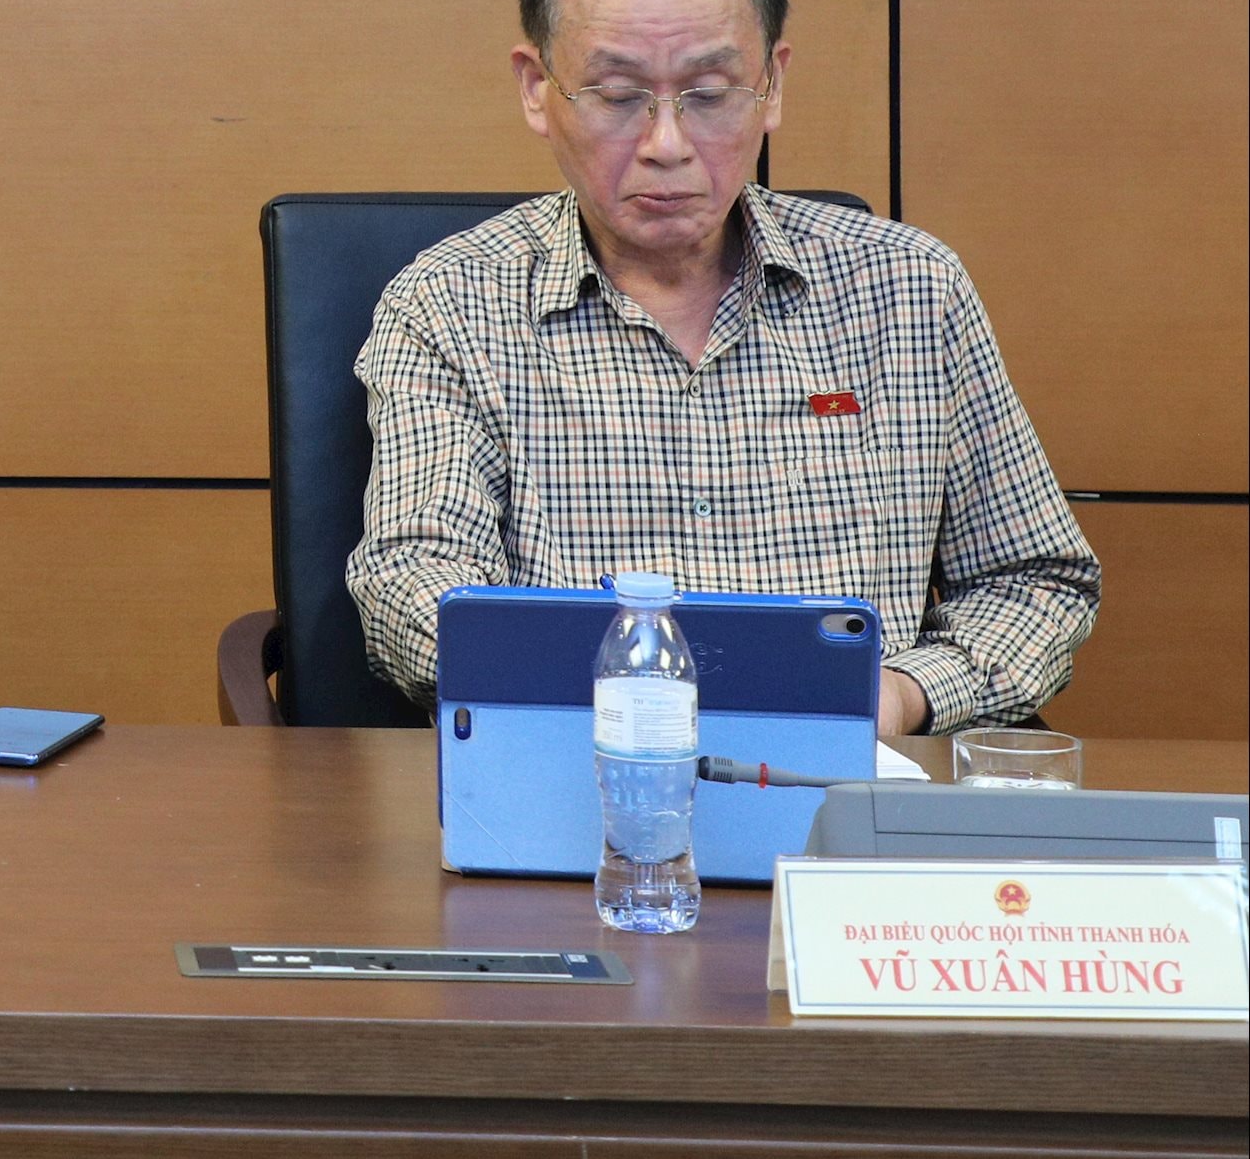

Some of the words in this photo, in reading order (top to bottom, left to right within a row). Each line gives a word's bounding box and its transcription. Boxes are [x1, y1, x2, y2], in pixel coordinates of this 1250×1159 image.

[844, 924, 877, 944] ĐẠI
[882, 920, 926, 942] BIỂU
[930, 921, 984, 944] QUỐC
[989, 923, 1023, 945] HỘI
[1028, 921, 1073, 942] TỈNH
[1078, 926, 1144, 943] THANH
[1148, 923, 1190, 943] HÓA
[858, 949, 918, 992] VŨ
[928, 948, 1048, 993] XUÂN
[1058, 950, 1186, 995] HÙNG
